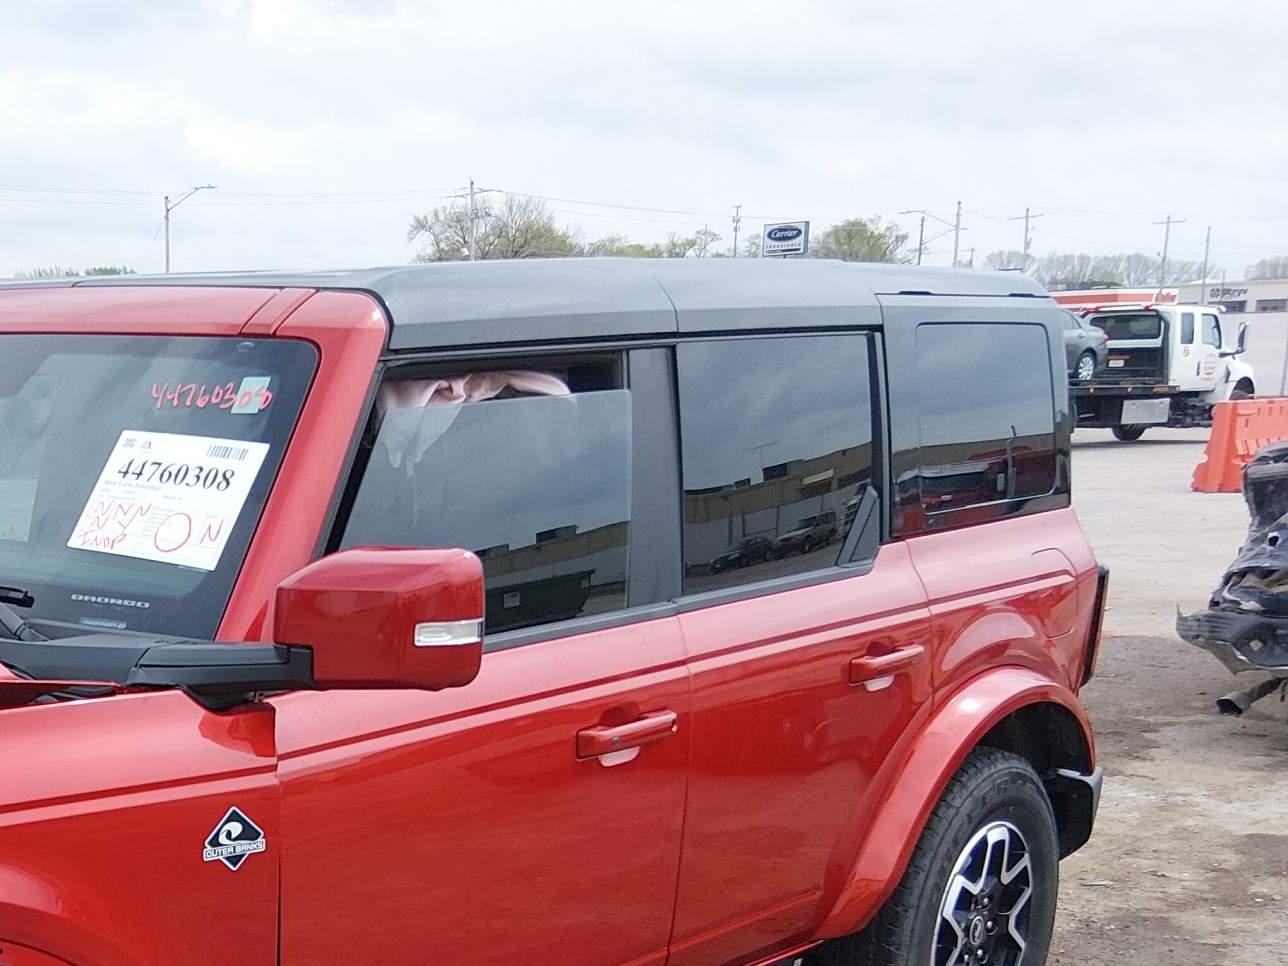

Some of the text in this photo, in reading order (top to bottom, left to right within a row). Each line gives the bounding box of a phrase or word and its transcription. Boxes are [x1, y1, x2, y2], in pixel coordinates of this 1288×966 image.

[772, 229, 799, 238] Carrier
[116, 458, 235, 492] 44760308
[71, 594, 150, 608] BRONCO
[206, 841, 263, 858] OUTER BANKS
